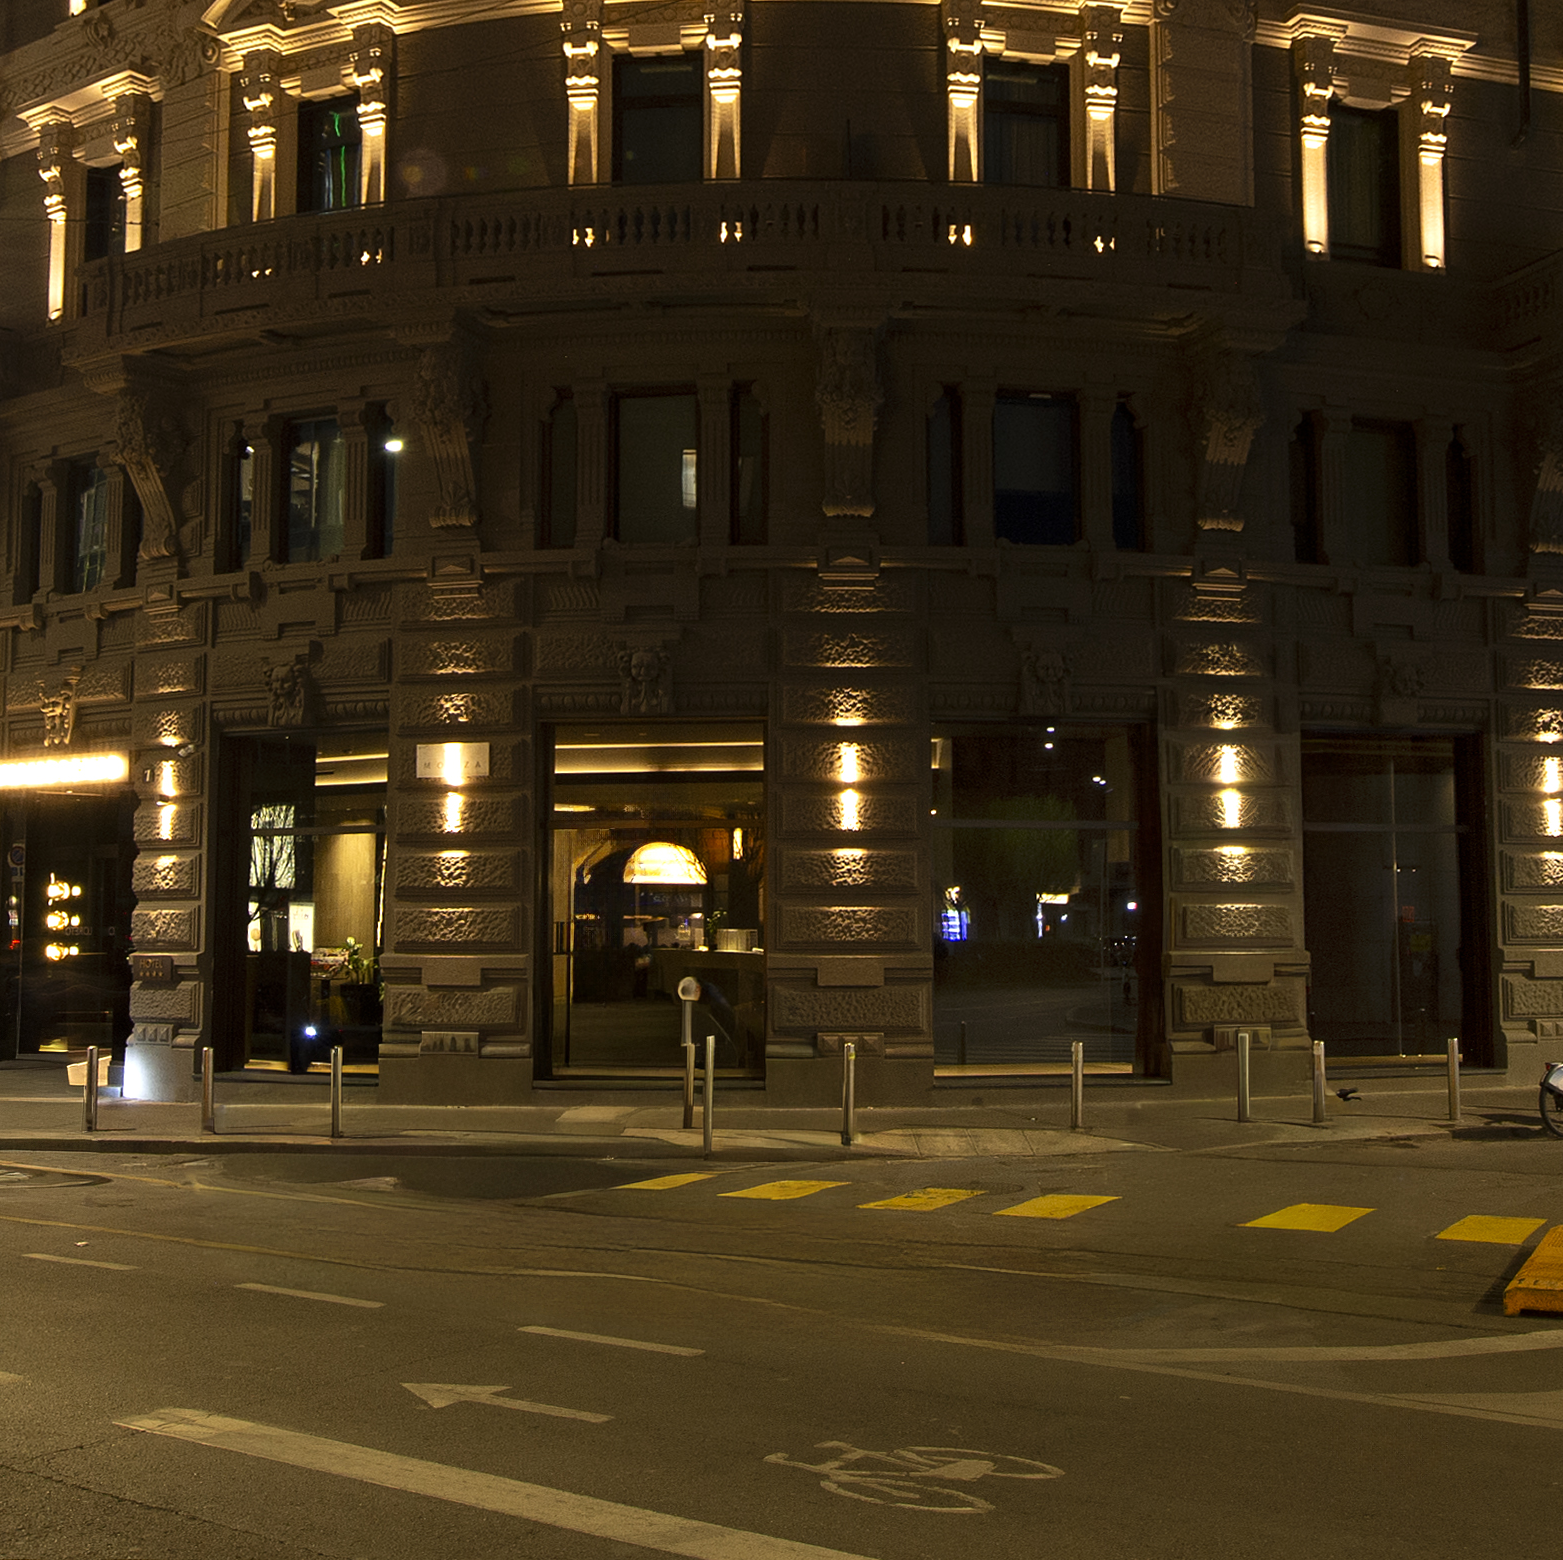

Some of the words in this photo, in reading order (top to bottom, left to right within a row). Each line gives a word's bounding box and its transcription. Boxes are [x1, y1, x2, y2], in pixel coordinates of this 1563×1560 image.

[423, 761, 482, 770] MOZA
[144, 769, 152, 782] 1
[139, 957, 164, 969] HOTEL
